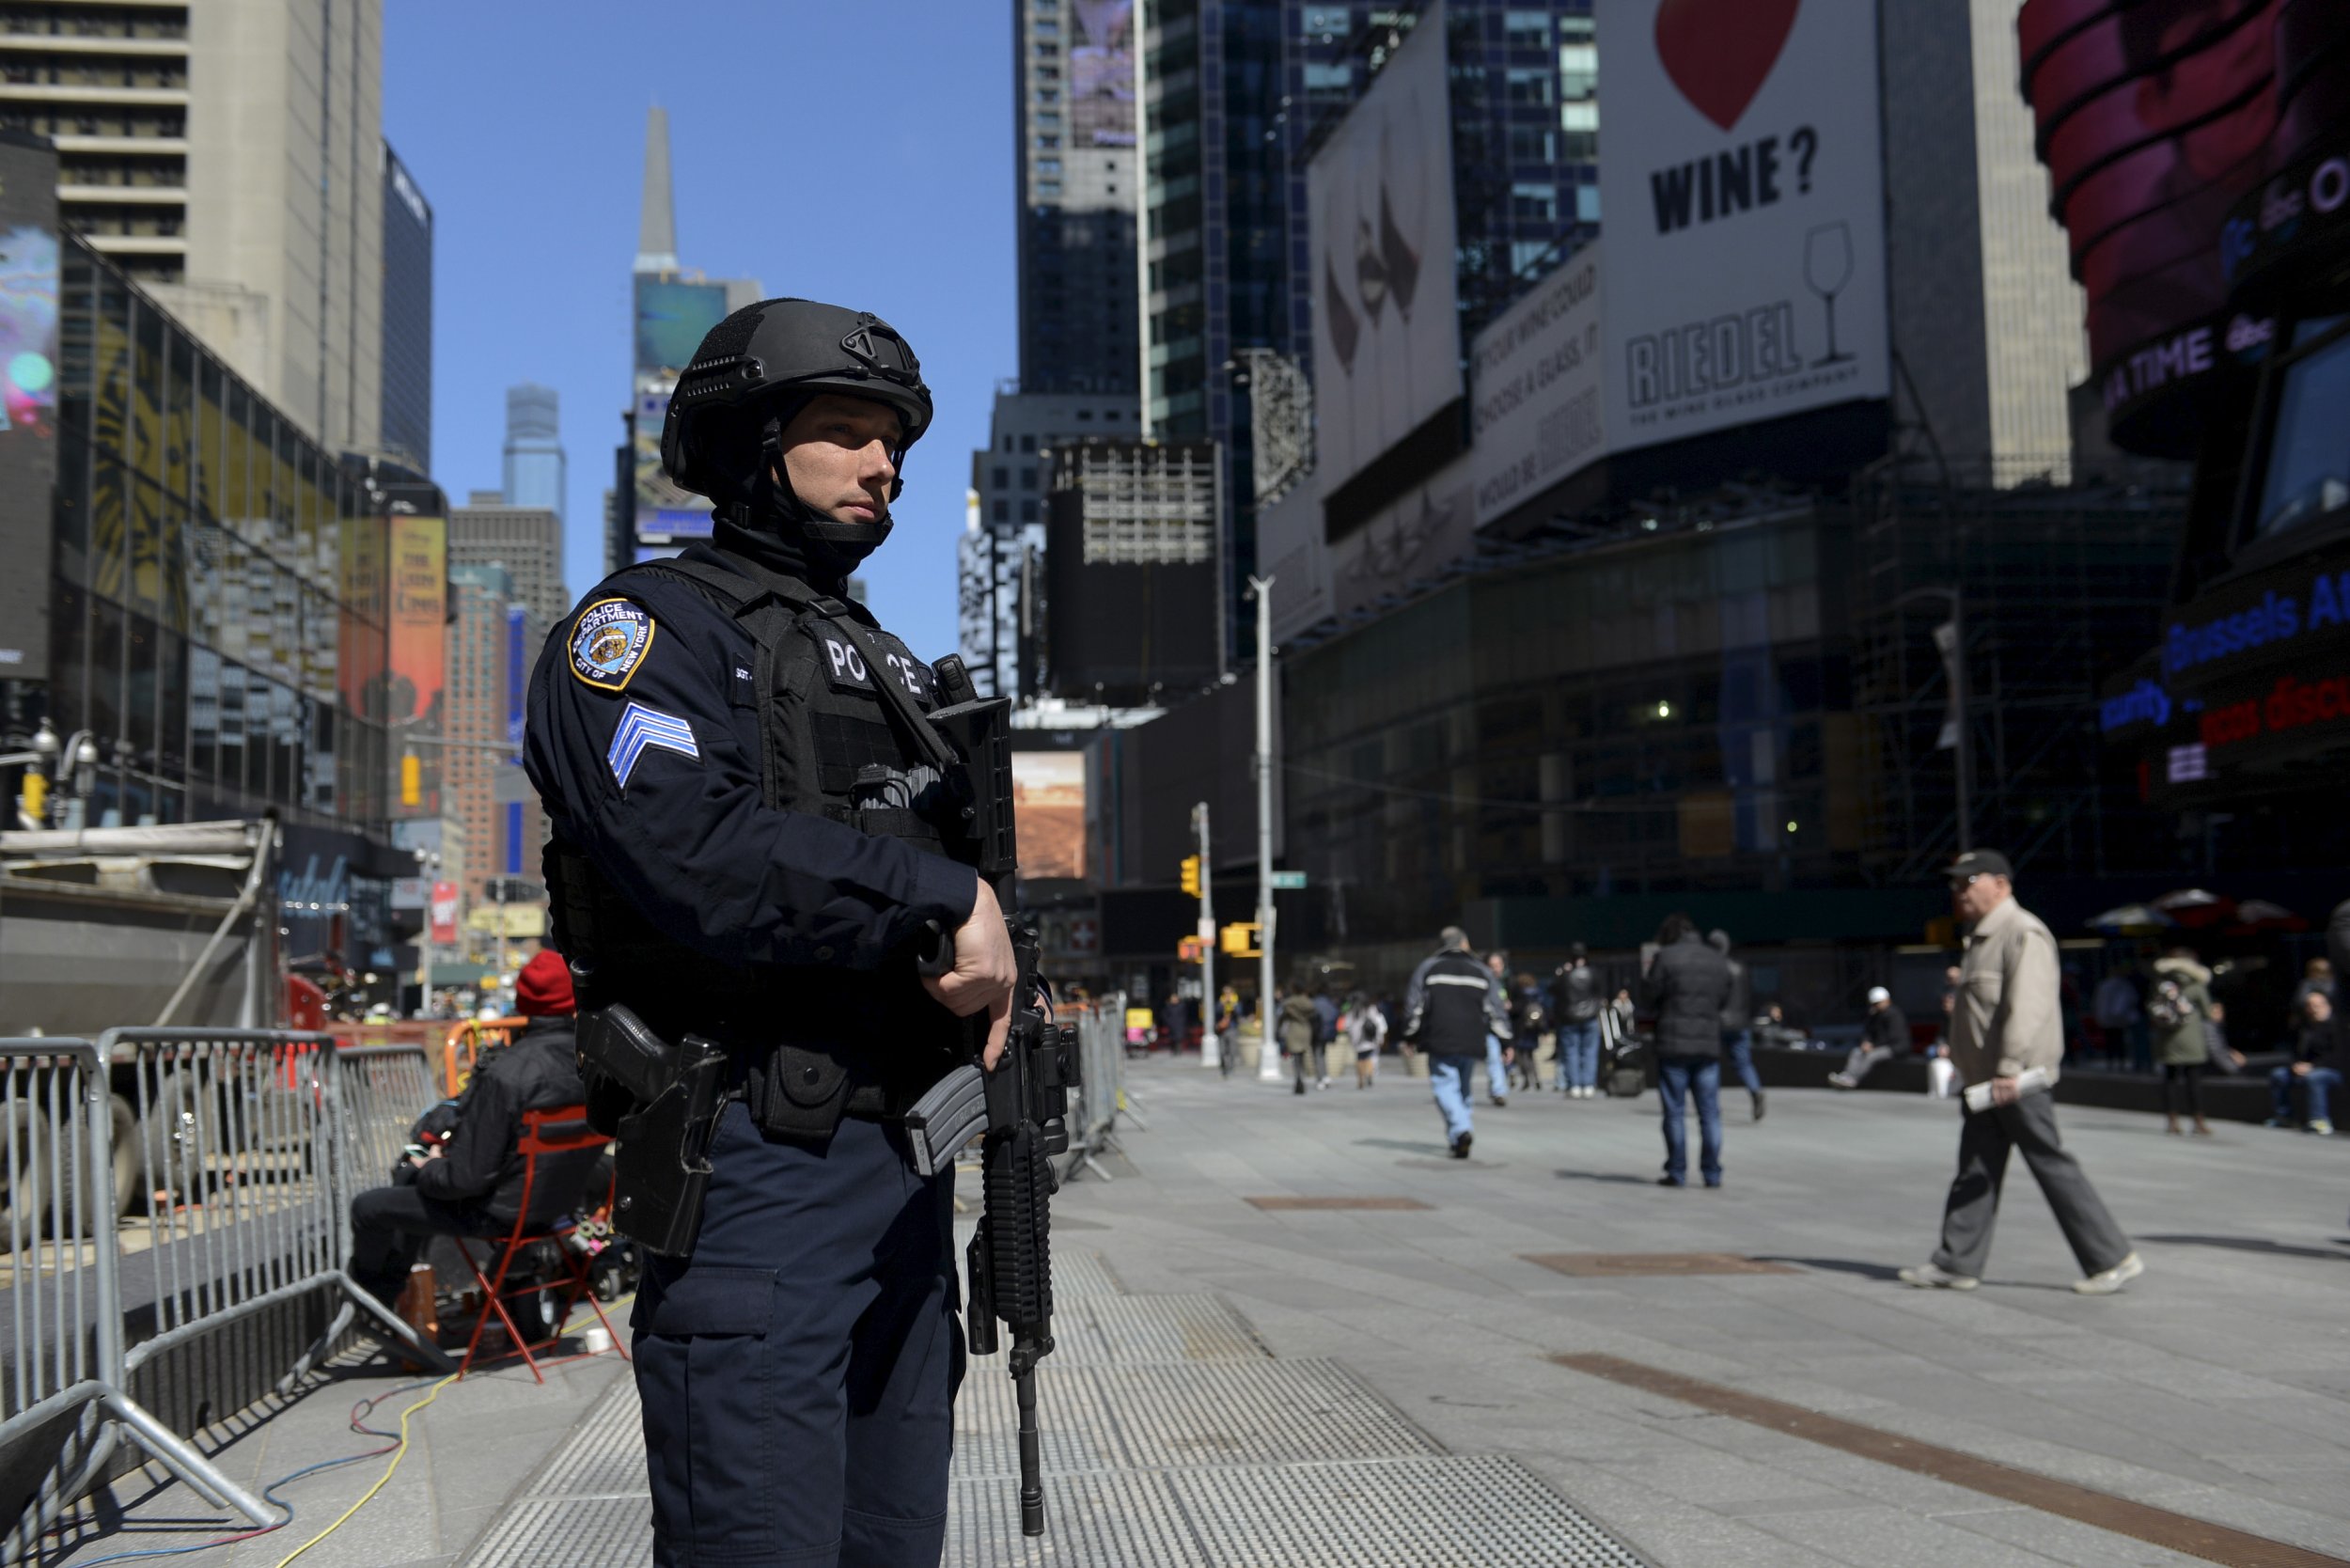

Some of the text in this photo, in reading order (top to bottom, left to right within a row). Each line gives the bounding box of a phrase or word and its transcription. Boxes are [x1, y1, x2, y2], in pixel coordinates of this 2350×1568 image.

[1651, 125, 1818, 235] WINE?
[1626, 300, 1803, 408] RIEDEL
[2128, 325, 2213, 394] TIME
[1629, 412, 1657, 427] THE
[1665, 401, 1706, 419] WINE
[1713, 389, 1765, 408] GLASS
[572, 611, 644, 653] DEPARTMENT
[580, 604, 624, 629] POLICE
[2168, 589, 2300, 672] Brussels
[575, 625, 649, 680] CITY OF NEW YORK
[736, 667, 749, 681] SGT
